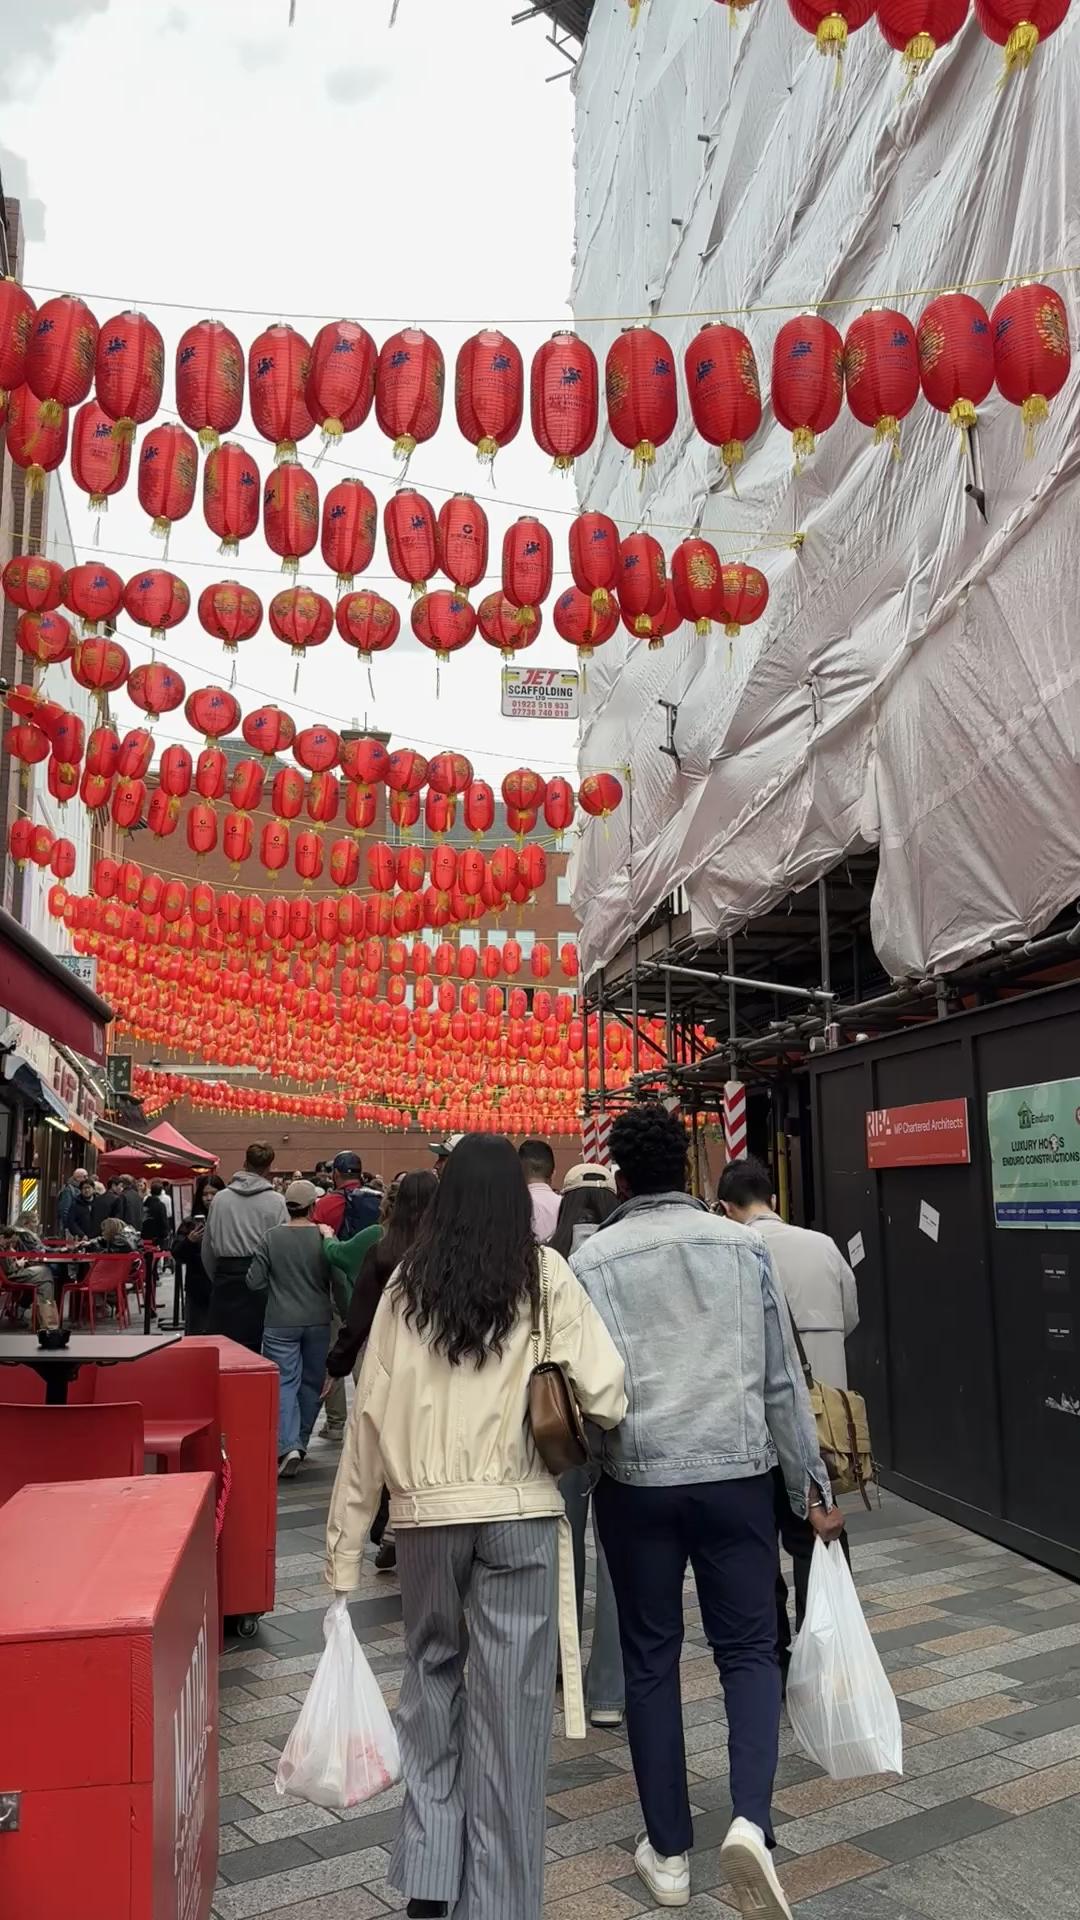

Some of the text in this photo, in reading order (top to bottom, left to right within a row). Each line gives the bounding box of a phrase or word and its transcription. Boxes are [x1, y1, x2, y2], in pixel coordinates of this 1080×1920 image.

[522, 670, 559, 686] JET
[508, 685, 573, 697] SCAFFOLDING
[866, 1110, 892, 1137] RIBA
[903, 1120, 931, 1134] Chartered
[931, 1117, 964, 1131] Architects
[1031, 1114, 1054, 1124] Enduro
[1011, 1137, 1065, 1152] LUXURY HOS
[1002, 1152, 1080, 1166] ENDURO CONSTRUCTIONS
